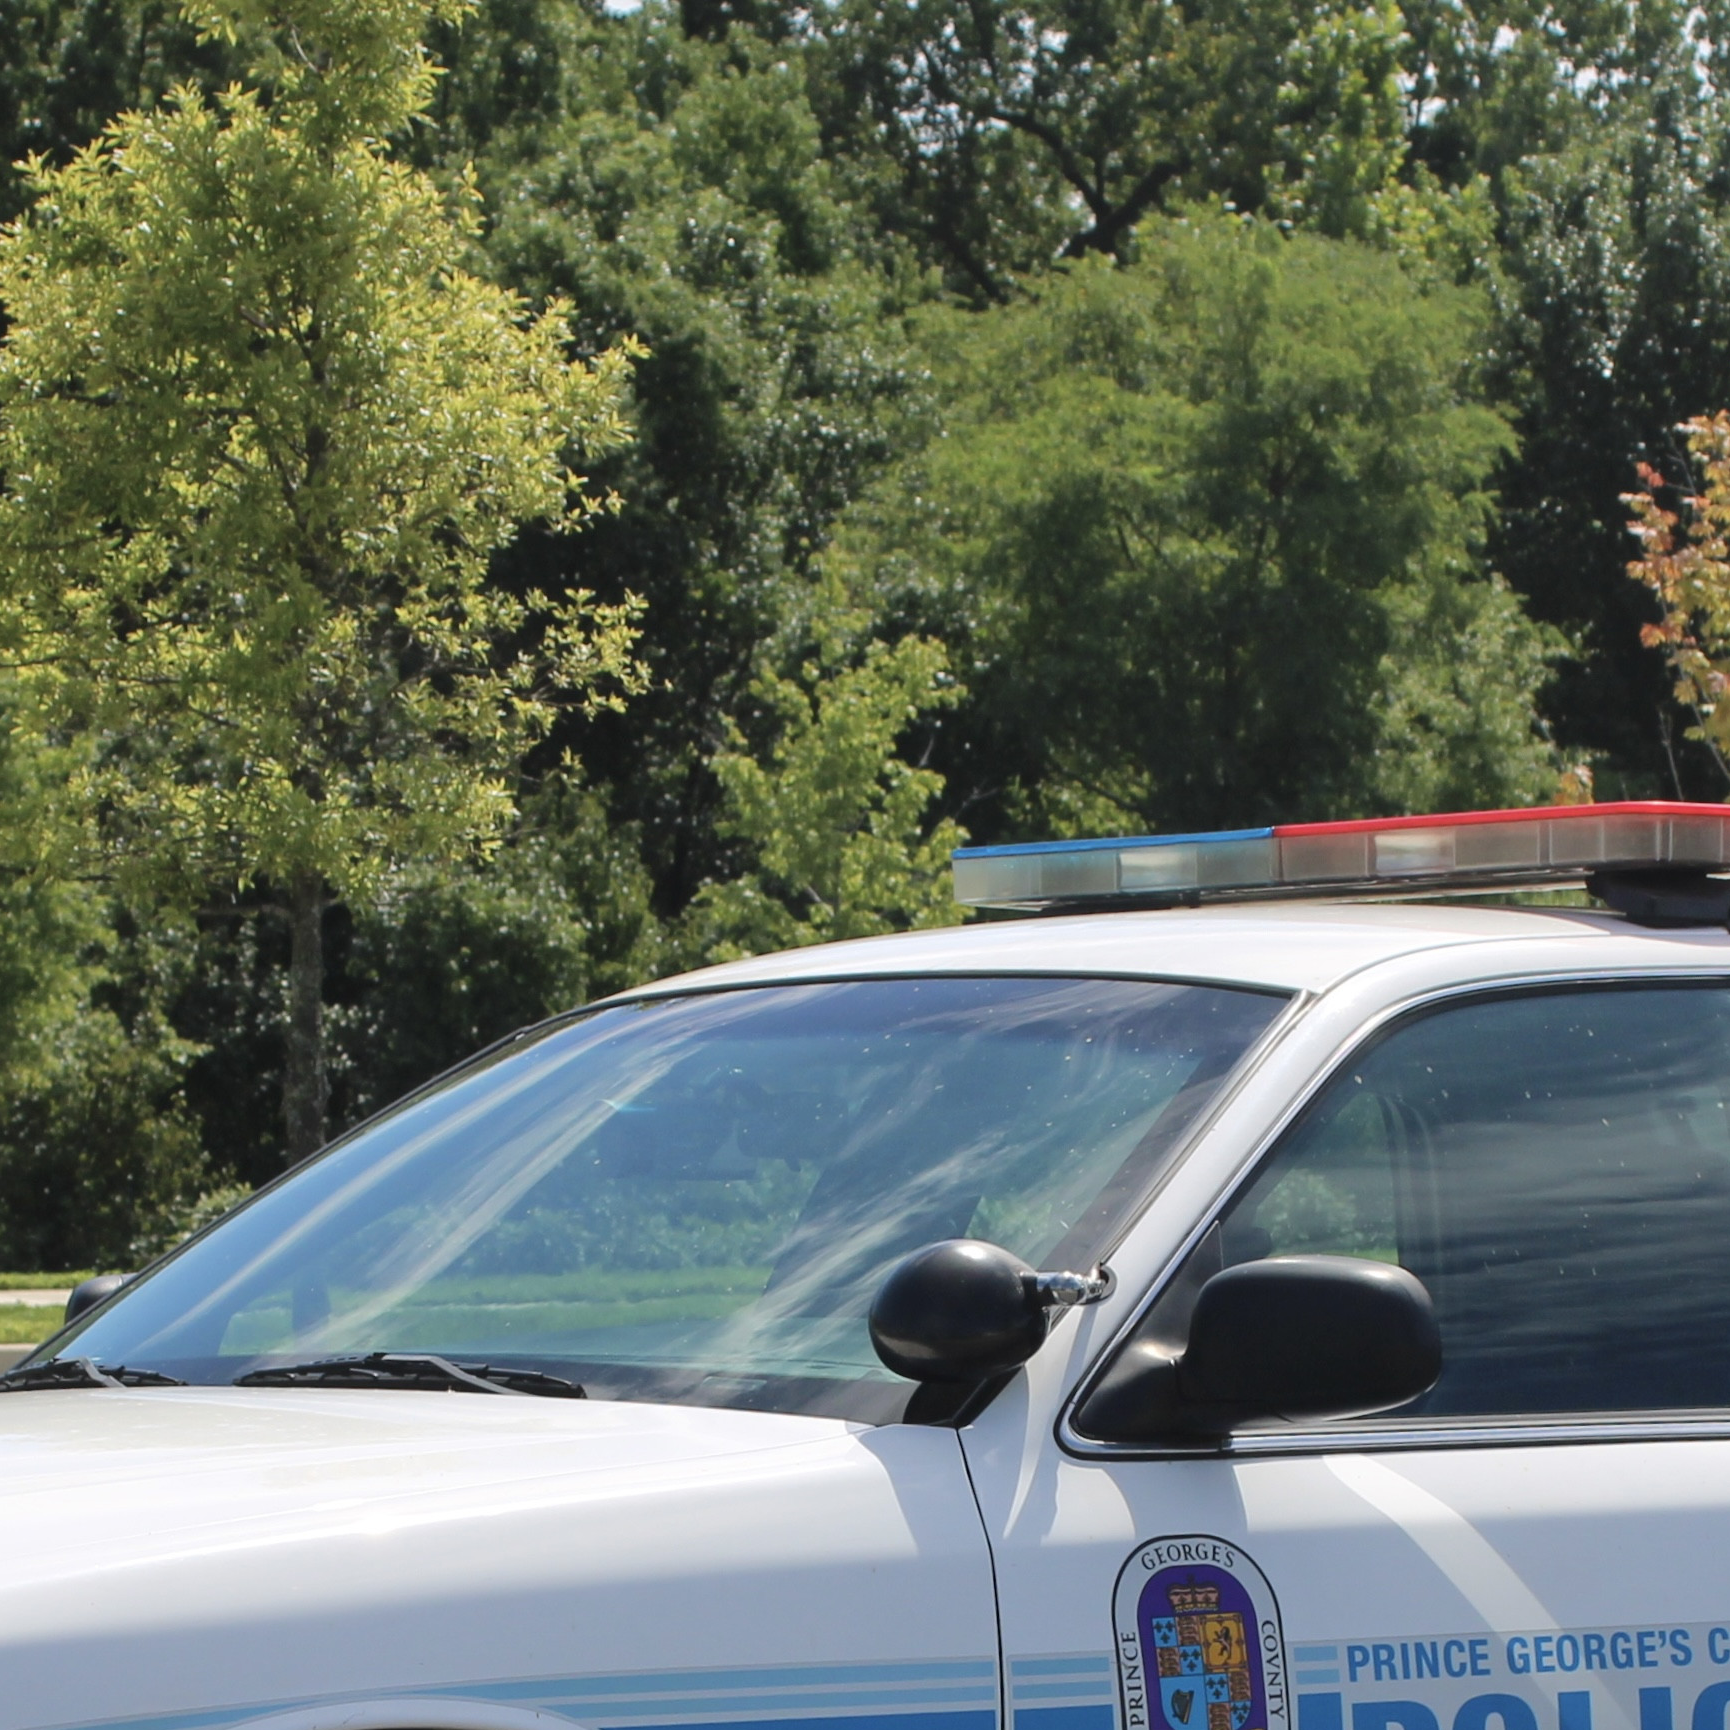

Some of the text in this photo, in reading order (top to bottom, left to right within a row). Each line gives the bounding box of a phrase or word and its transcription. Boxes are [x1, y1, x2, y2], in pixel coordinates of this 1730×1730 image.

[1121, 1631, 1146, 1727] PRINCE
[1141, 1542, 1236, 1571] GEORGE'S
[1347, 1639, 1491, 1683] PRINCE
[1506, 1628, 1693, 1675] GEORGE'S
